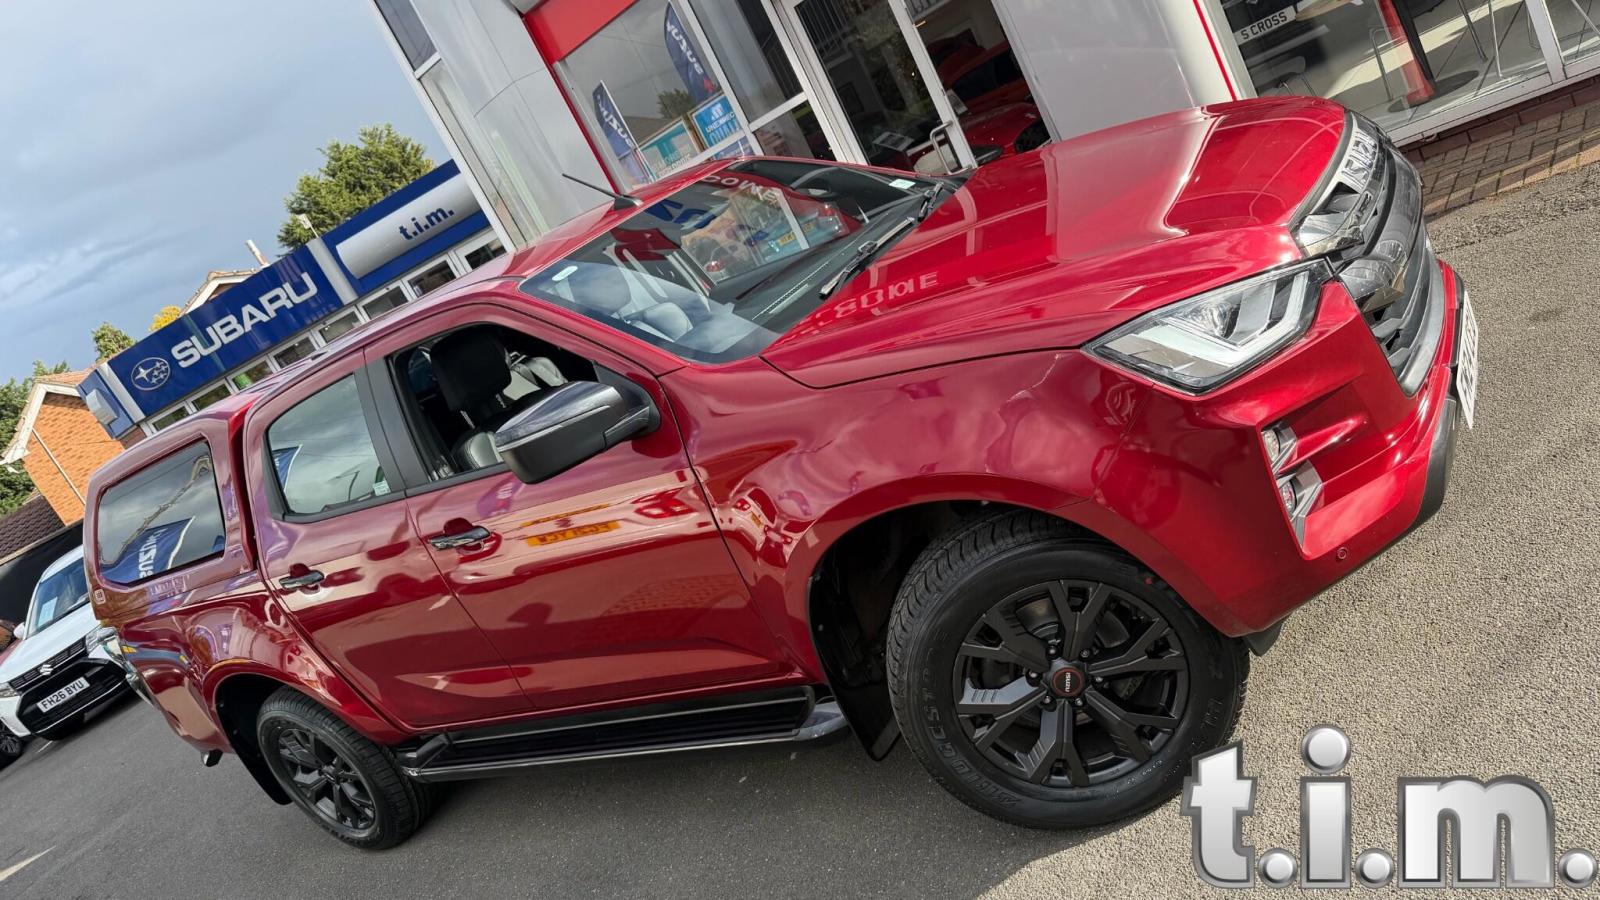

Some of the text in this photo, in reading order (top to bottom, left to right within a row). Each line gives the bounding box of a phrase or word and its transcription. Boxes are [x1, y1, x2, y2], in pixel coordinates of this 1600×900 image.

[1241, 11, 1288, 40] S CROSS
[398, 204, 455, 241] t.i.m.
[171, 271, 318, 369] SUBARU
[41, 680, 85, 709] FH26 BYU
[1064, 672, 1072, 693] ISUZU
